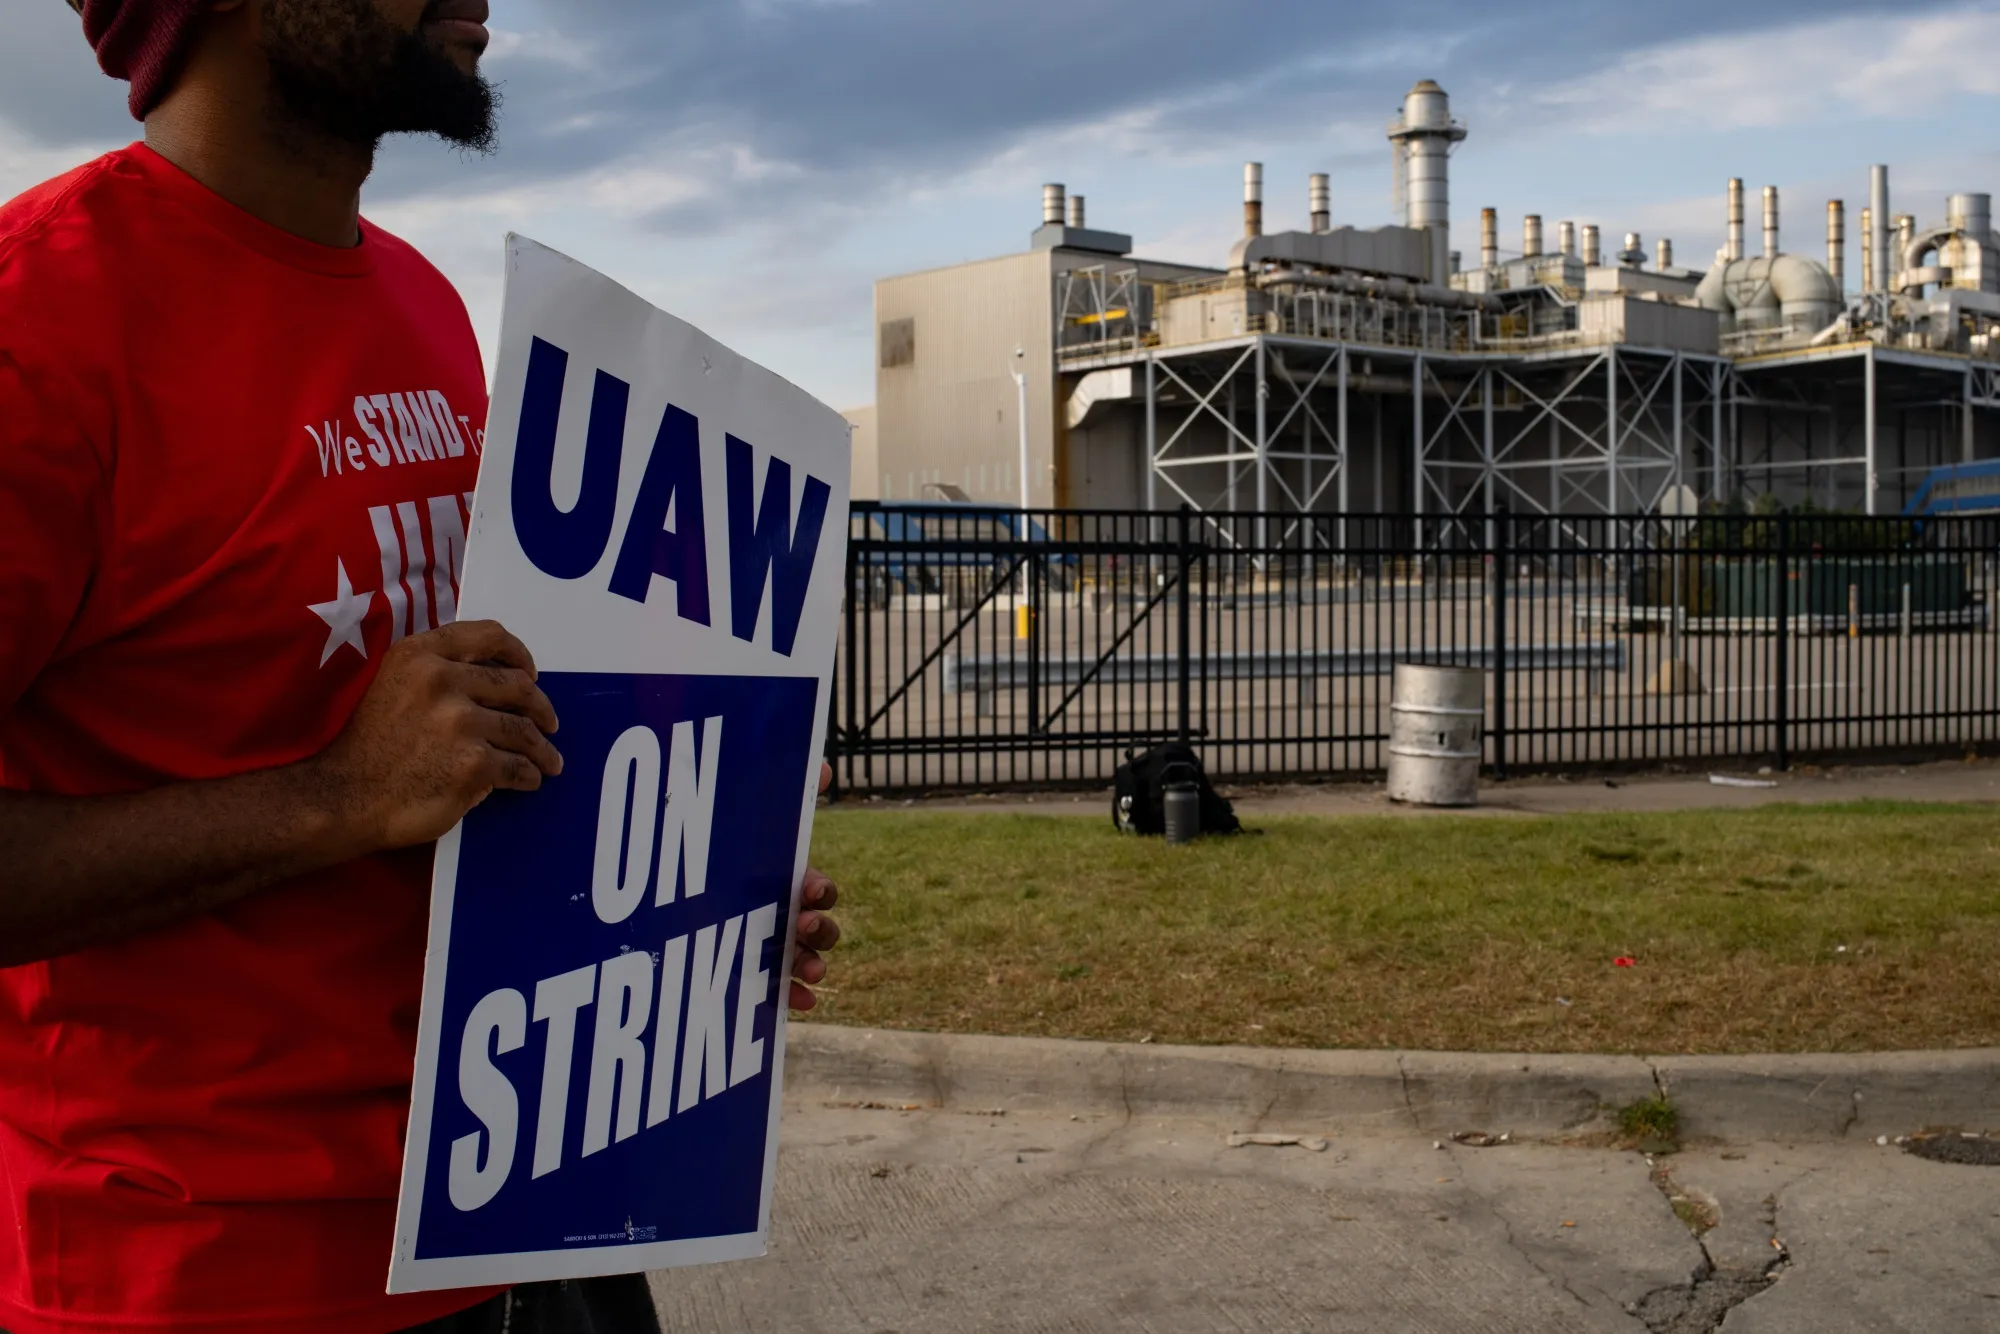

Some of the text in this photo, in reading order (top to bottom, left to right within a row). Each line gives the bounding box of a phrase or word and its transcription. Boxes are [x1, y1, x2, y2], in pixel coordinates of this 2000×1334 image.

[304, 420, 366, 478] We
[354, 390, 465, 467] STAND
[511, 335, 831, 657] UAW
[592, 716, 723, 924] ON
[449, 902, 777, 1212] STRIKE
